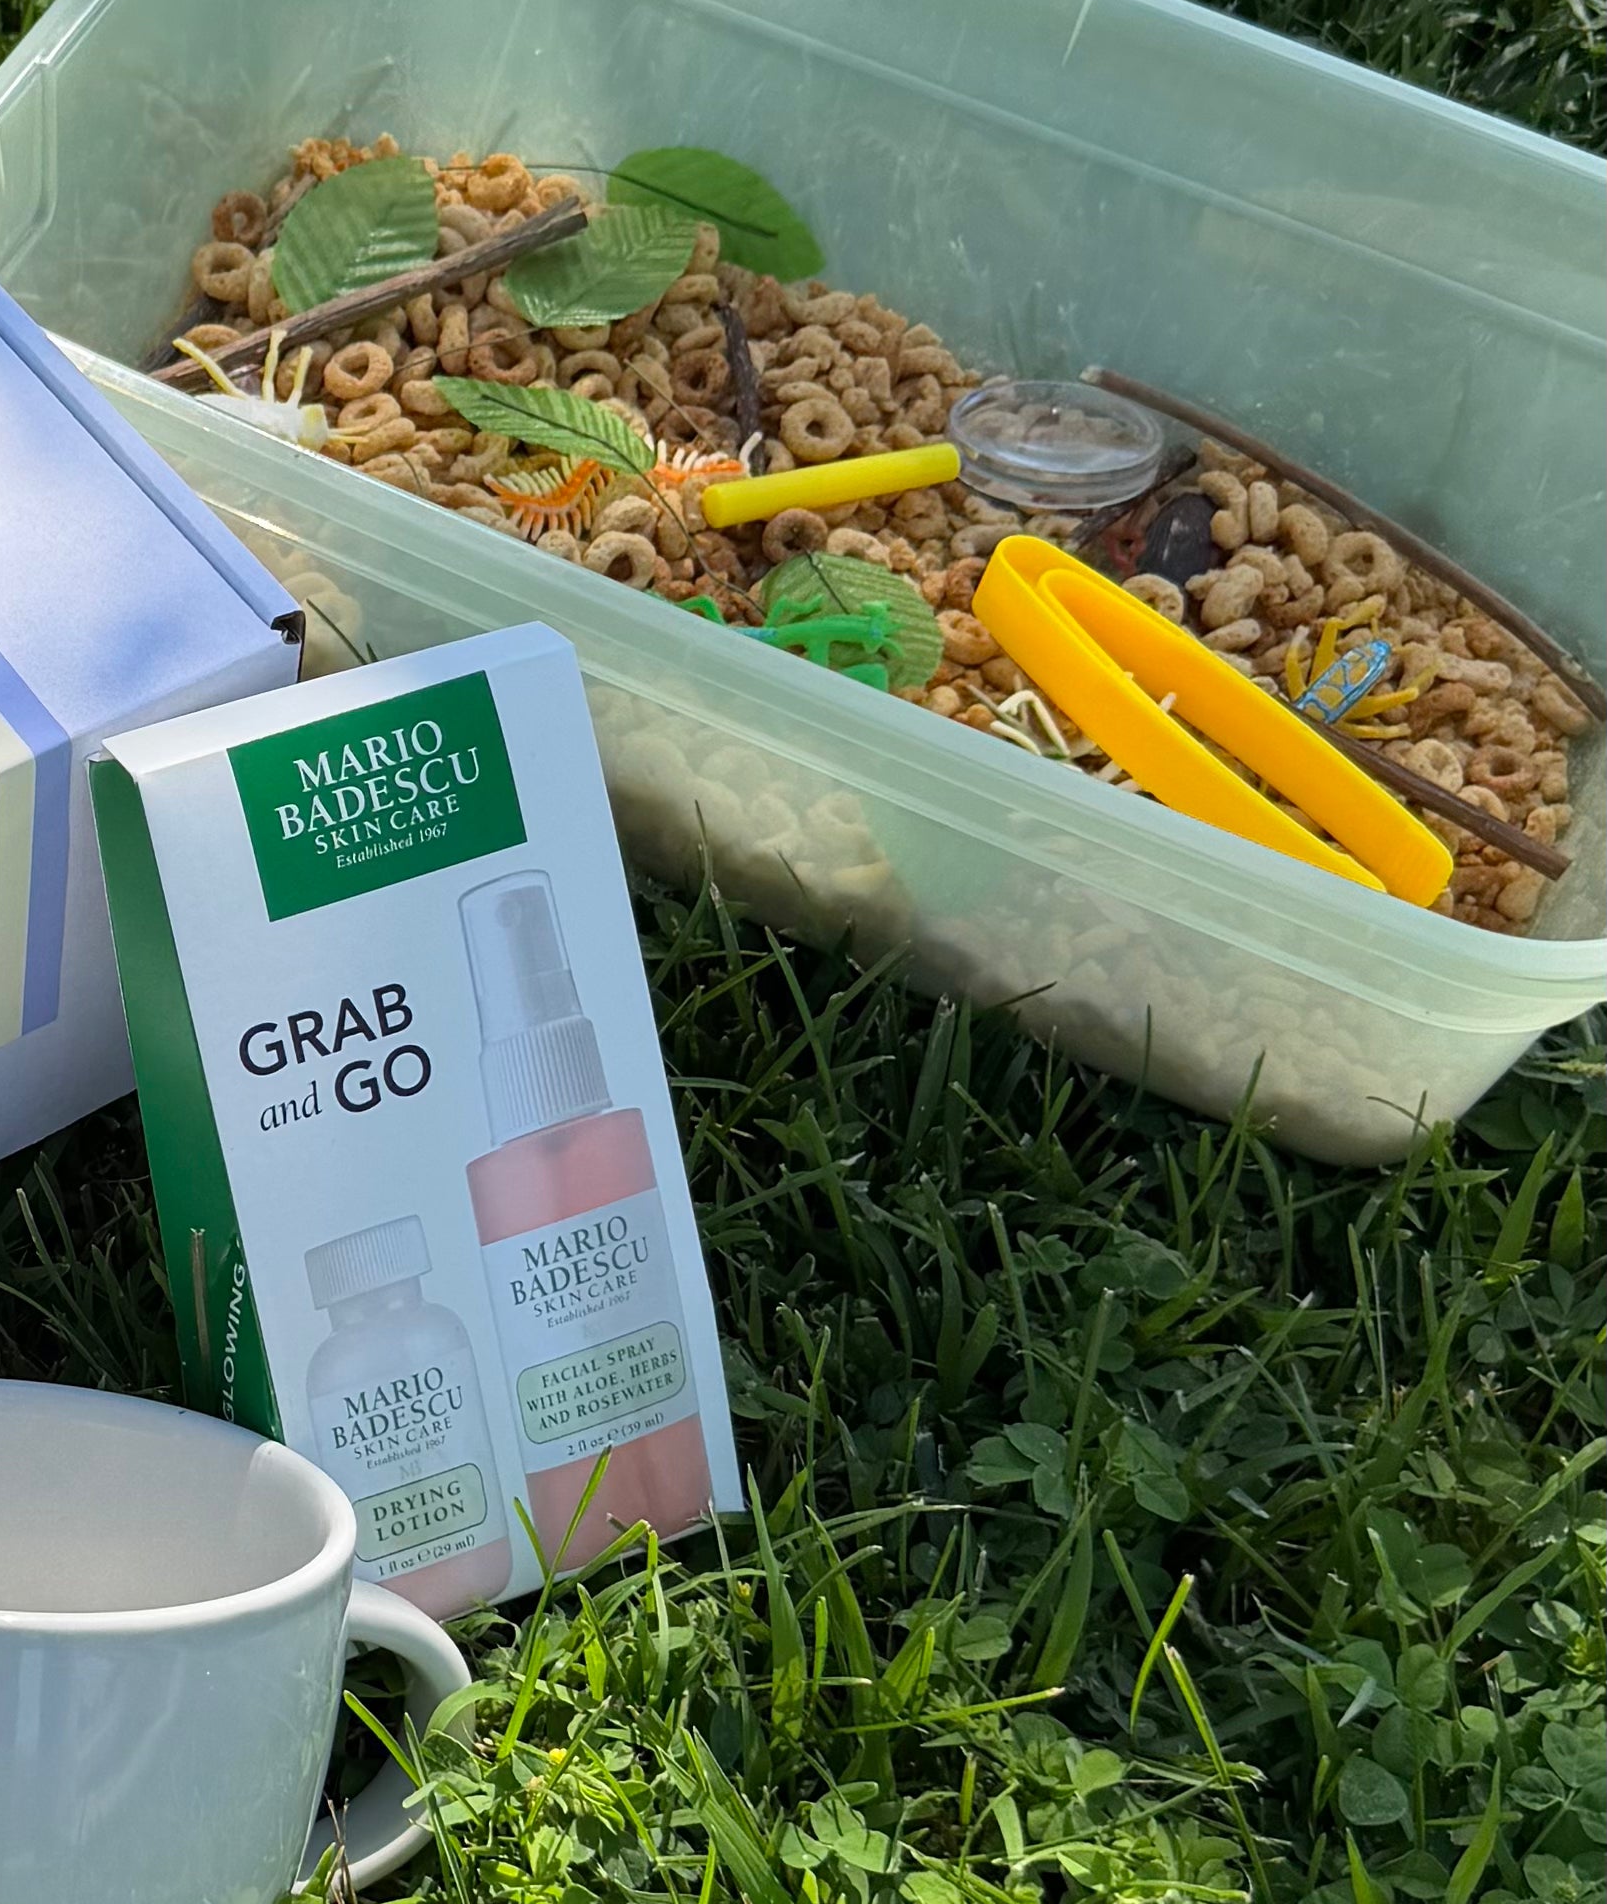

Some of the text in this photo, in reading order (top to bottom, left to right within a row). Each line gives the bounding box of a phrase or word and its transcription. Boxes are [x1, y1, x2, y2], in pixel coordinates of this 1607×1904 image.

[293, 720, 443, 793] MARIO
[274, 746, 480, 840] BADESCU
[315, 793, 460, 855] SKIN CARE
[336, 822, 447, 869] Established 1967
[239, 983, 413, 1076] GRAB
[259, 1044, 432, 1131] and GO
[510, 1236, 649, 1306] BADESCU
[521, 1215, 627, 1272] MARIO
[533, 1269, 638, 1318] SKIN CARE
[547, 1300, 605, 1329] Established
[223, 1263, 246, 1424] GLOWING
[541, 1336, 656, 1389] FACIAL SPRAY
[343, 1367, 443, 1419] MARIO
[526, 1389, 567, 1413] WITH
[629, 1349, 678, 1378] HERBS
[538, 1371, 674, 1431] AND ROSEWATER
[331, 1386, 463, 1449] BADESCU
[353, 1416, 453, 1460] SKIN CARE
[366, 1446, 421, 1470] Established
[567, 1444, 575, 1457] 2
[590, 1436, 604, 1448] oz
[373, 1480, 461, 1522] DRYING
[375, 1499, 466, 1542] LOTION
[401, 1556, 414, 1568] oz
